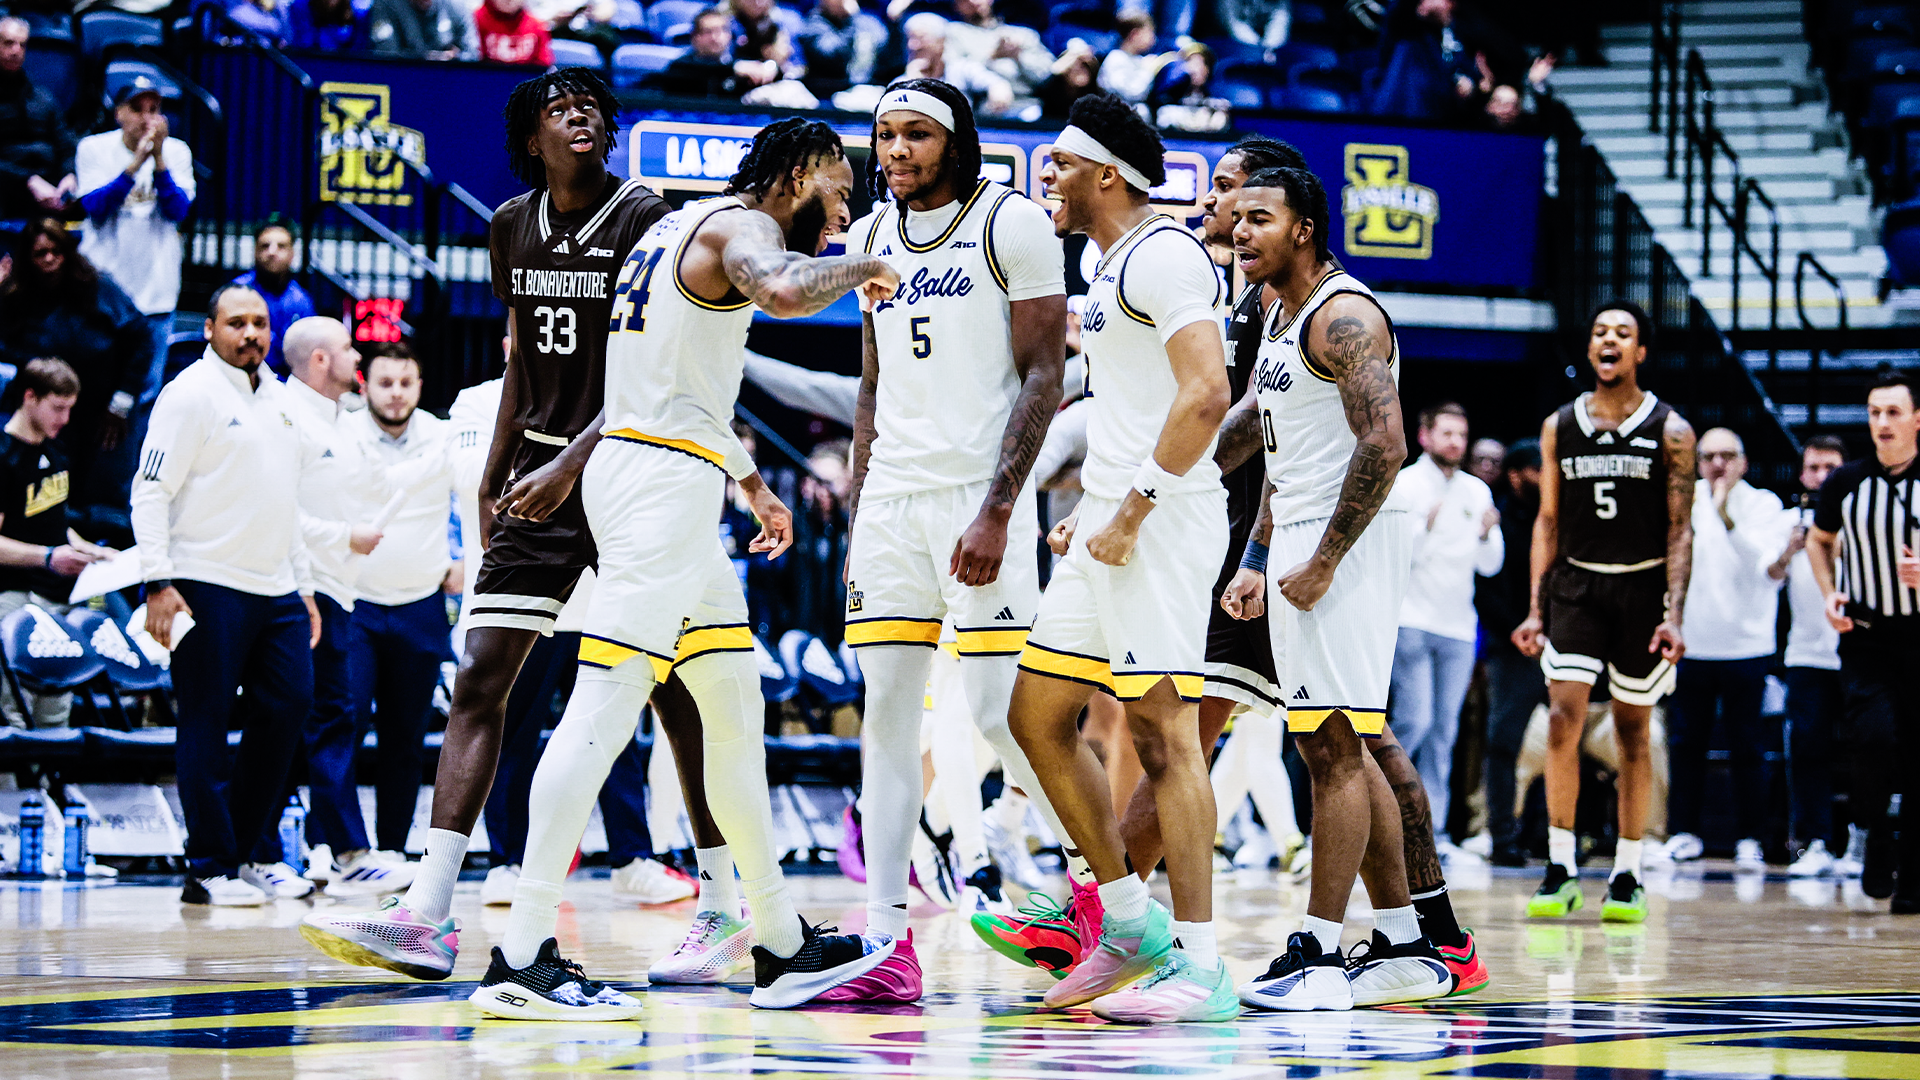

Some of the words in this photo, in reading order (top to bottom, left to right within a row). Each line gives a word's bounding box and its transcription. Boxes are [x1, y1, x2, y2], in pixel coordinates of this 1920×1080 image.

[512, 268, 524, 296] ST.
[525, 269, 608, 299] BONAVENTURE
[609, 245, 668, 334] 24
[907, 266, 974, 305] Salle
[534, 305, 577, 355] 33
[910, 315, 932, 360] 5
[1258, 357, 1293, 395] Salle
[1260, 408, 1278, 455] 0
[1594, 481, 1617, 519] 5
